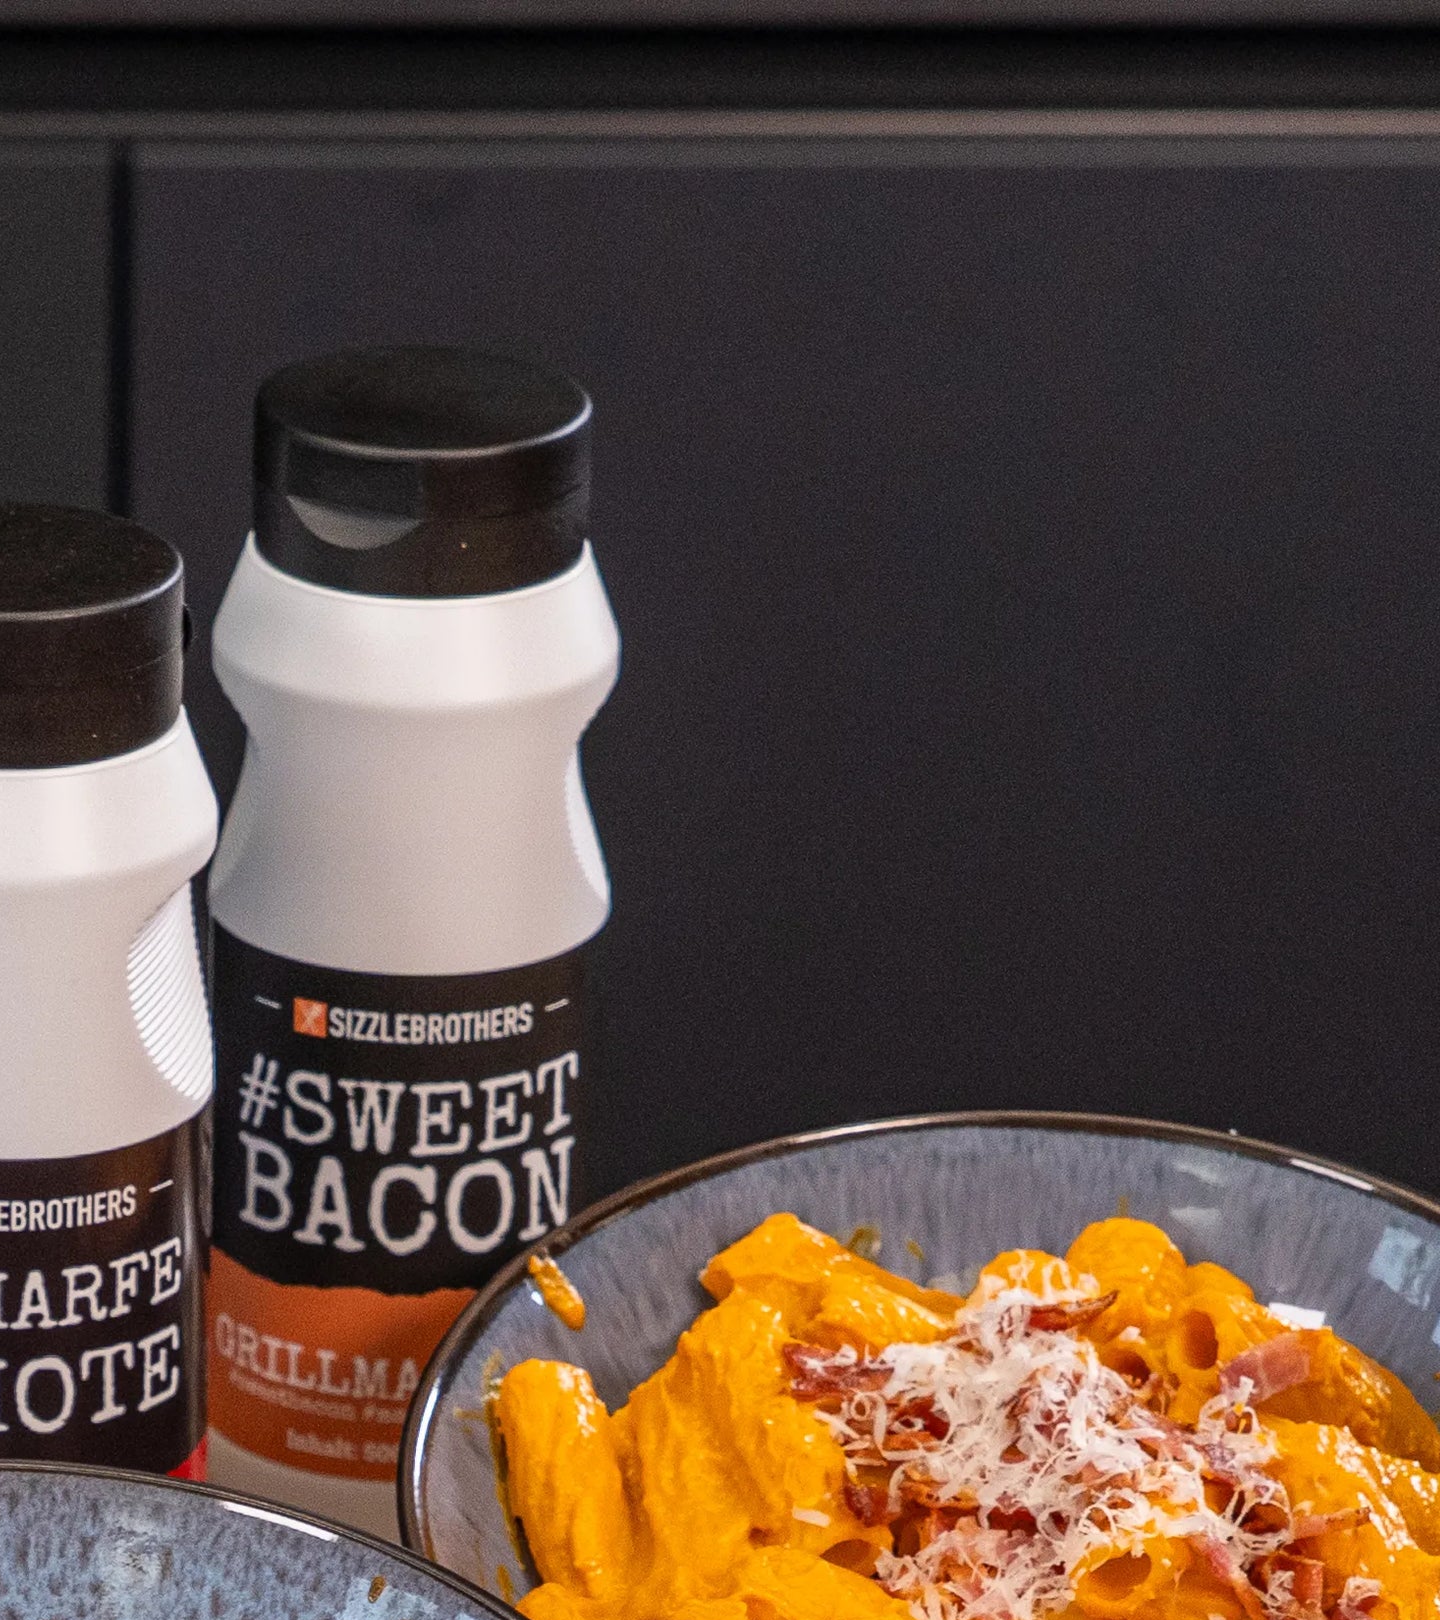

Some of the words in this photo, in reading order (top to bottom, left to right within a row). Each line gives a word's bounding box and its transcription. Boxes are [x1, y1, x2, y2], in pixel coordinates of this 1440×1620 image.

[328, 1003, 534, 1045] SIZZLEBROTHERS
[239, 1050, 580, 1158] #SWEET
[238, 1130, 576, 1256] BACON
[216, 1312, 420, 1400] GRILLMA
